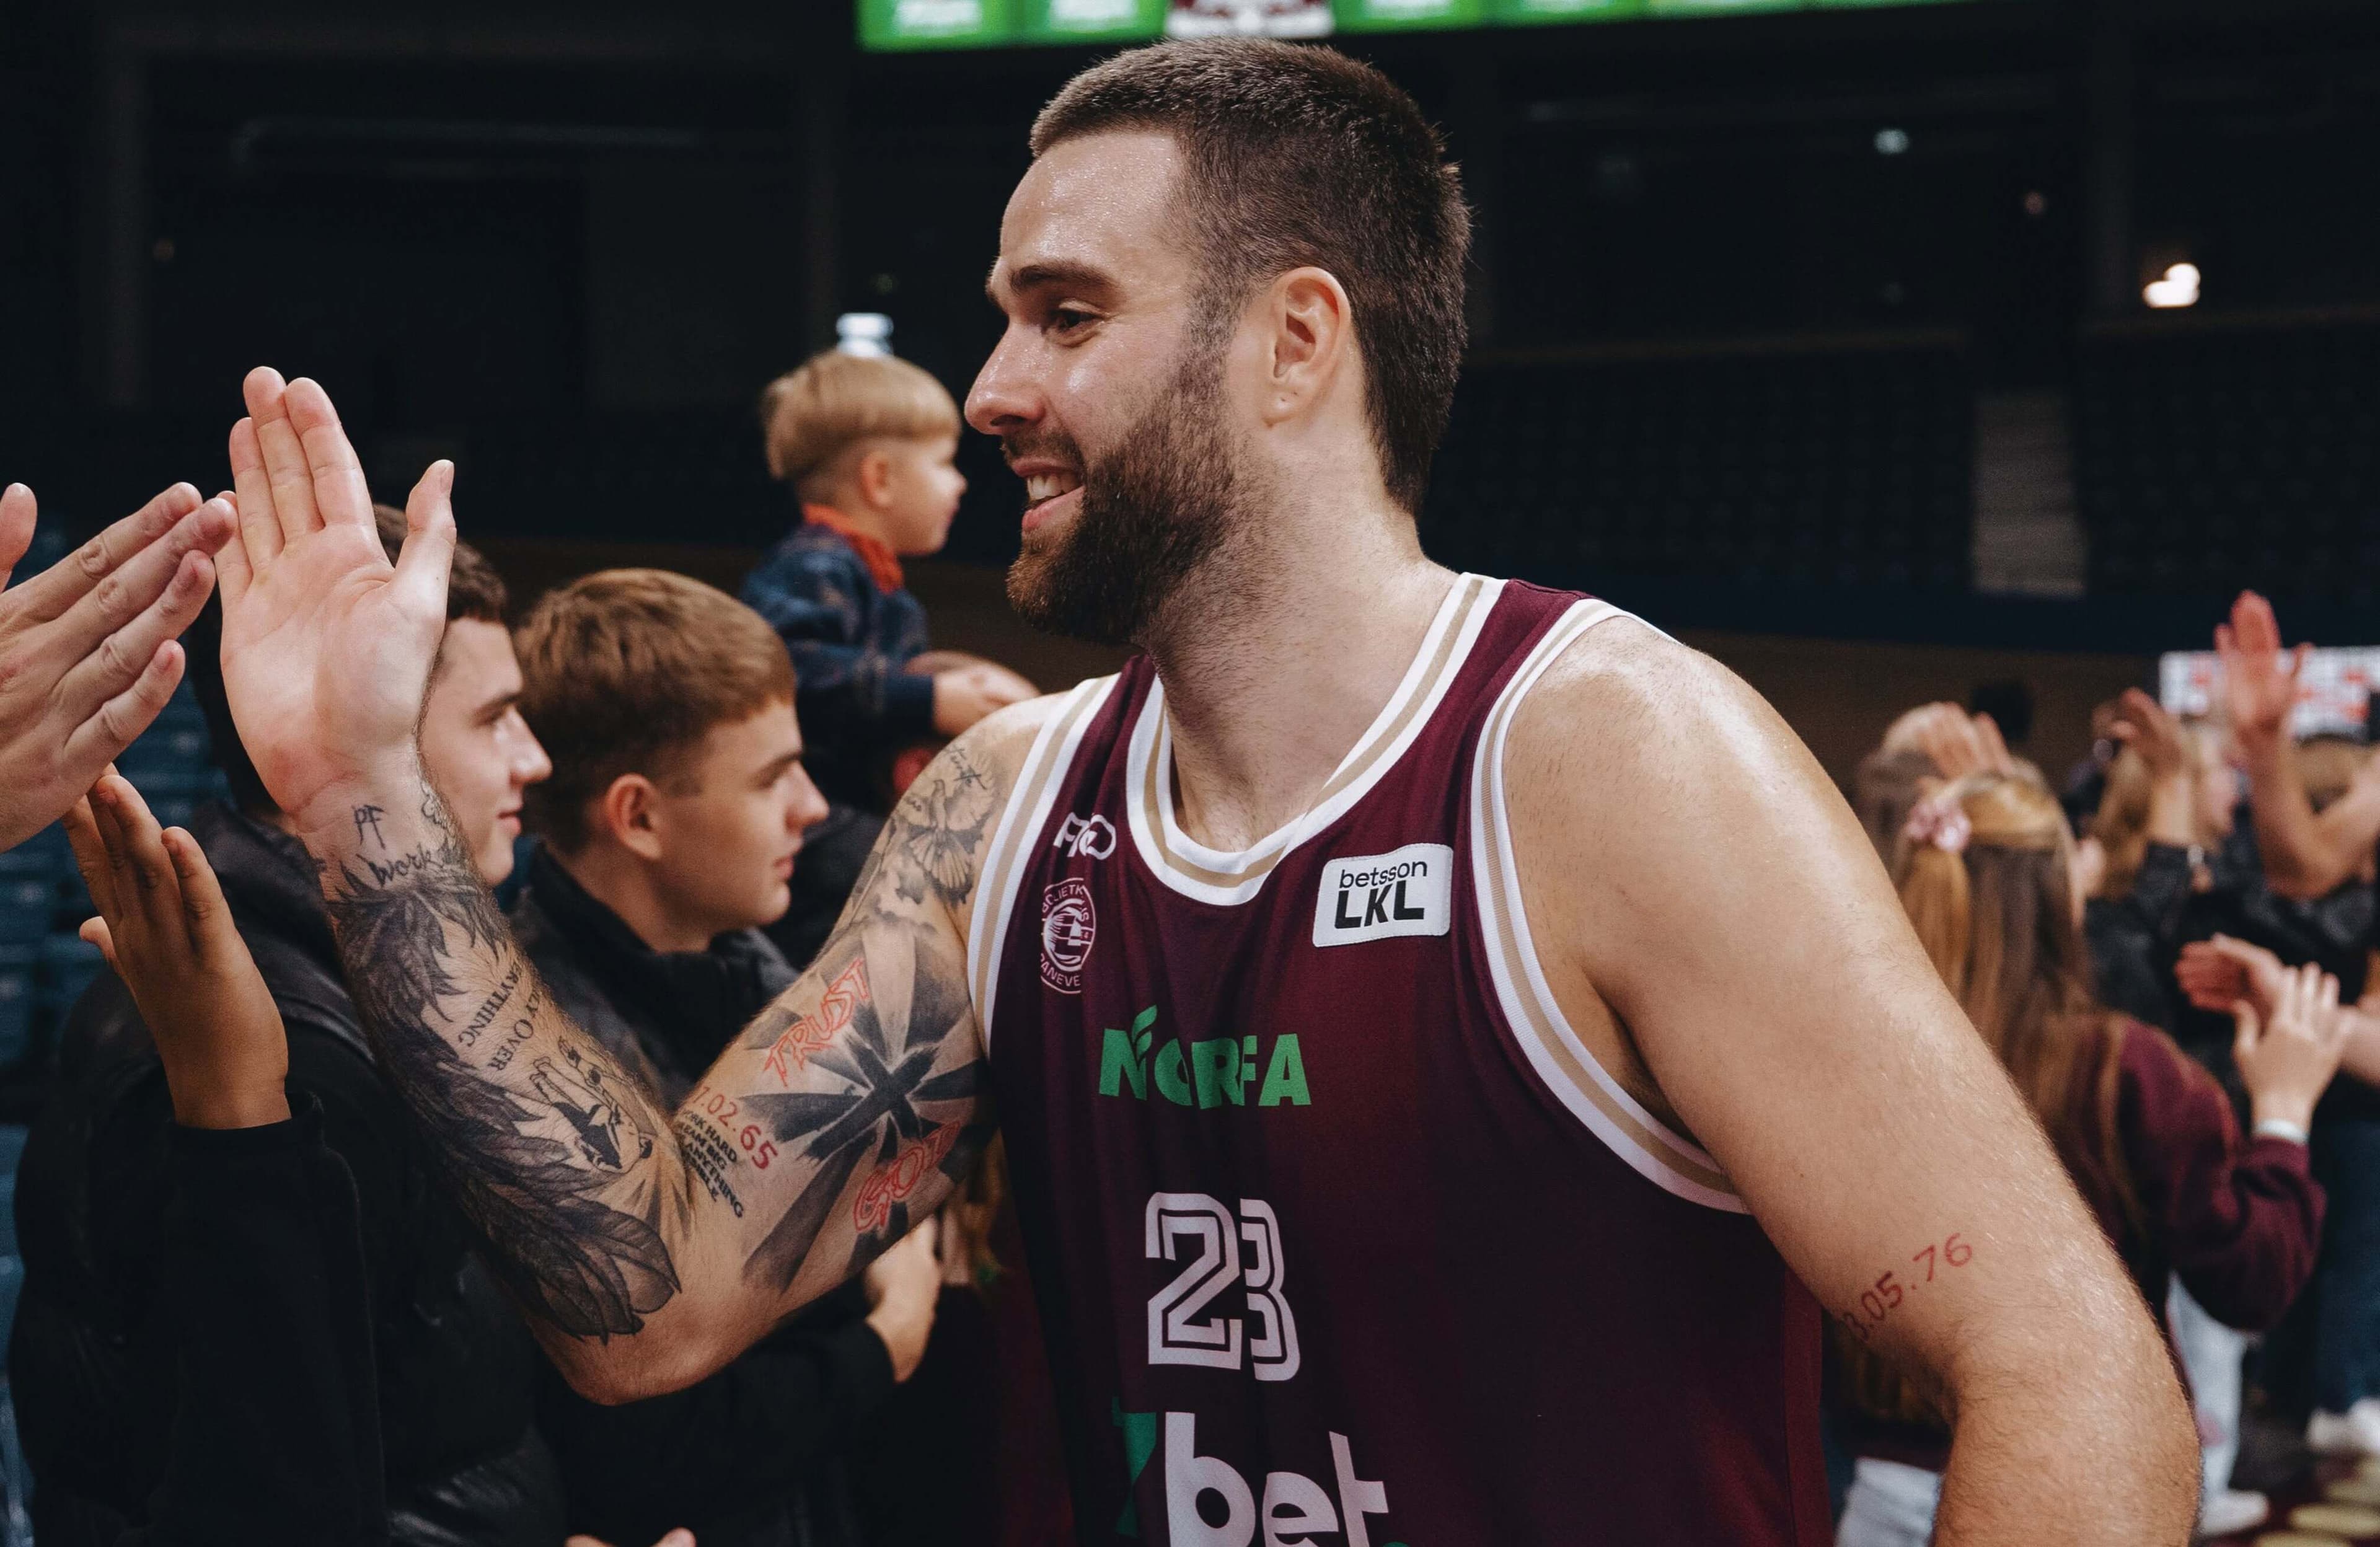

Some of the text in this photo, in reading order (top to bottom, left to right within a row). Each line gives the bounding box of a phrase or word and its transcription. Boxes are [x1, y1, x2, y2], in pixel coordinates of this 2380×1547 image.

[1334, 880, 1425, 929] LKL
[1339, 861, 1428, 889] betsson
[763, 958, 868, 1088] TRUST
[1098, 1005, 1311, 1109] NORFA
[705, 1125, 738, 1163] HARD
[1145, 1191, 1300, 1381] 23
